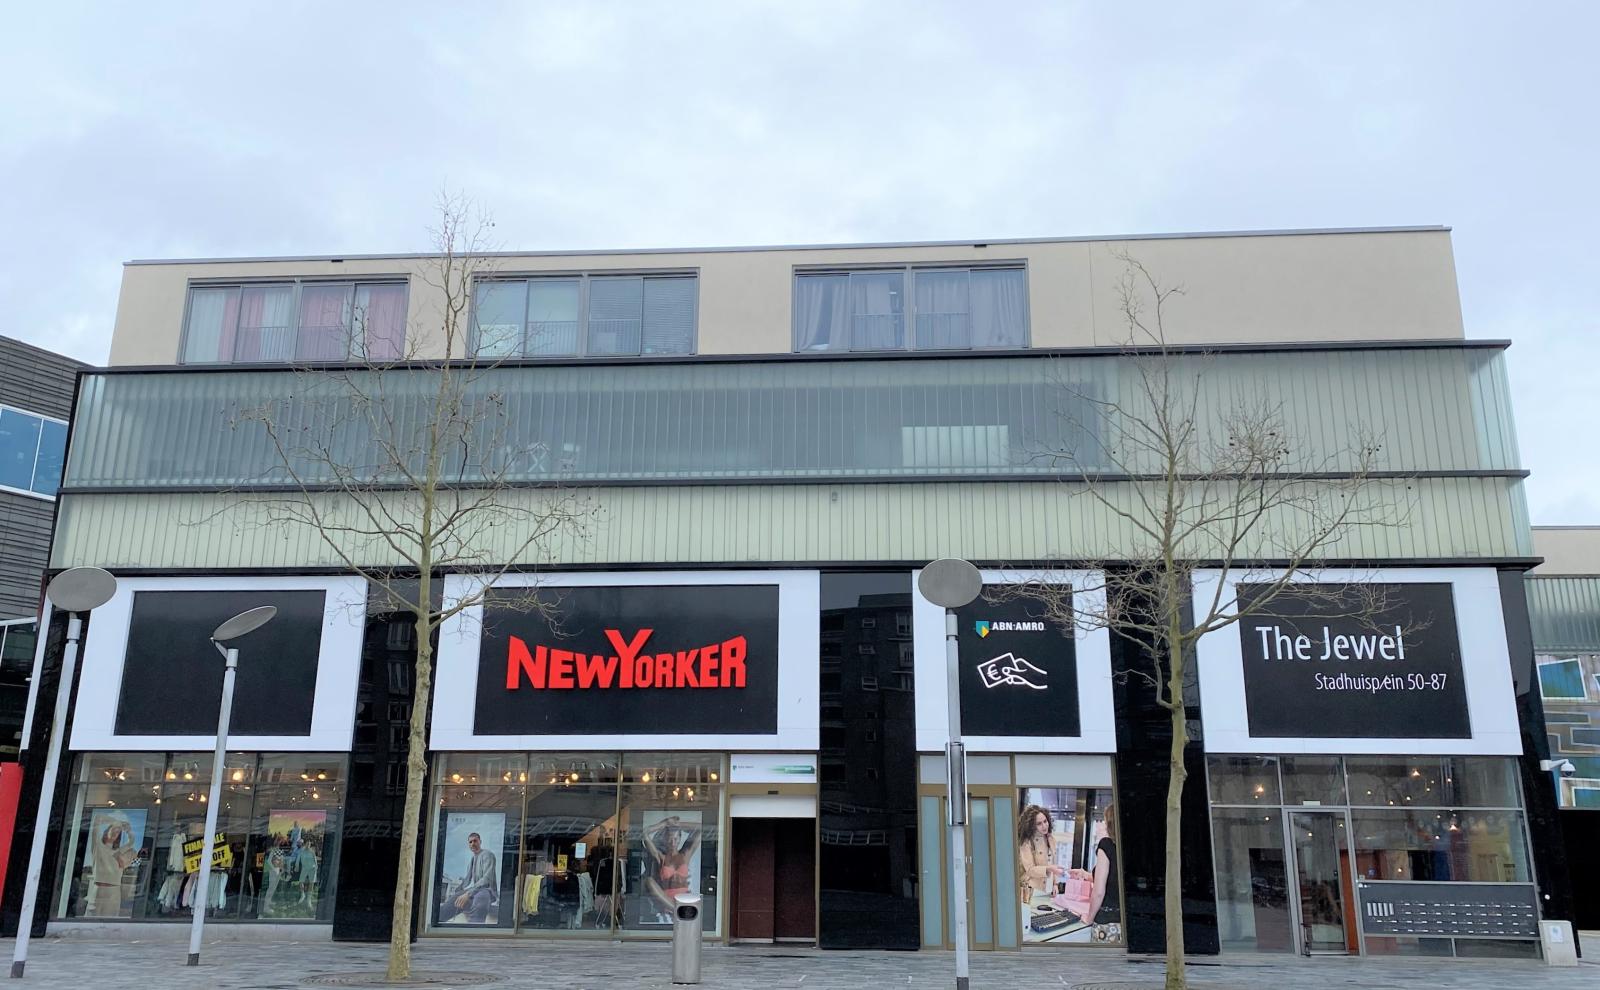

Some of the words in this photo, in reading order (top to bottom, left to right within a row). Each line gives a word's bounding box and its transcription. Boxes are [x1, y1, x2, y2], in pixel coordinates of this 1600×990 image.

[1255, 625, 1311, 660] The
[1320, 625, 1405, 661] Jewel
[1407, 673, 1447, 691] 50-87
[213, 850, 225, 861] OFF
